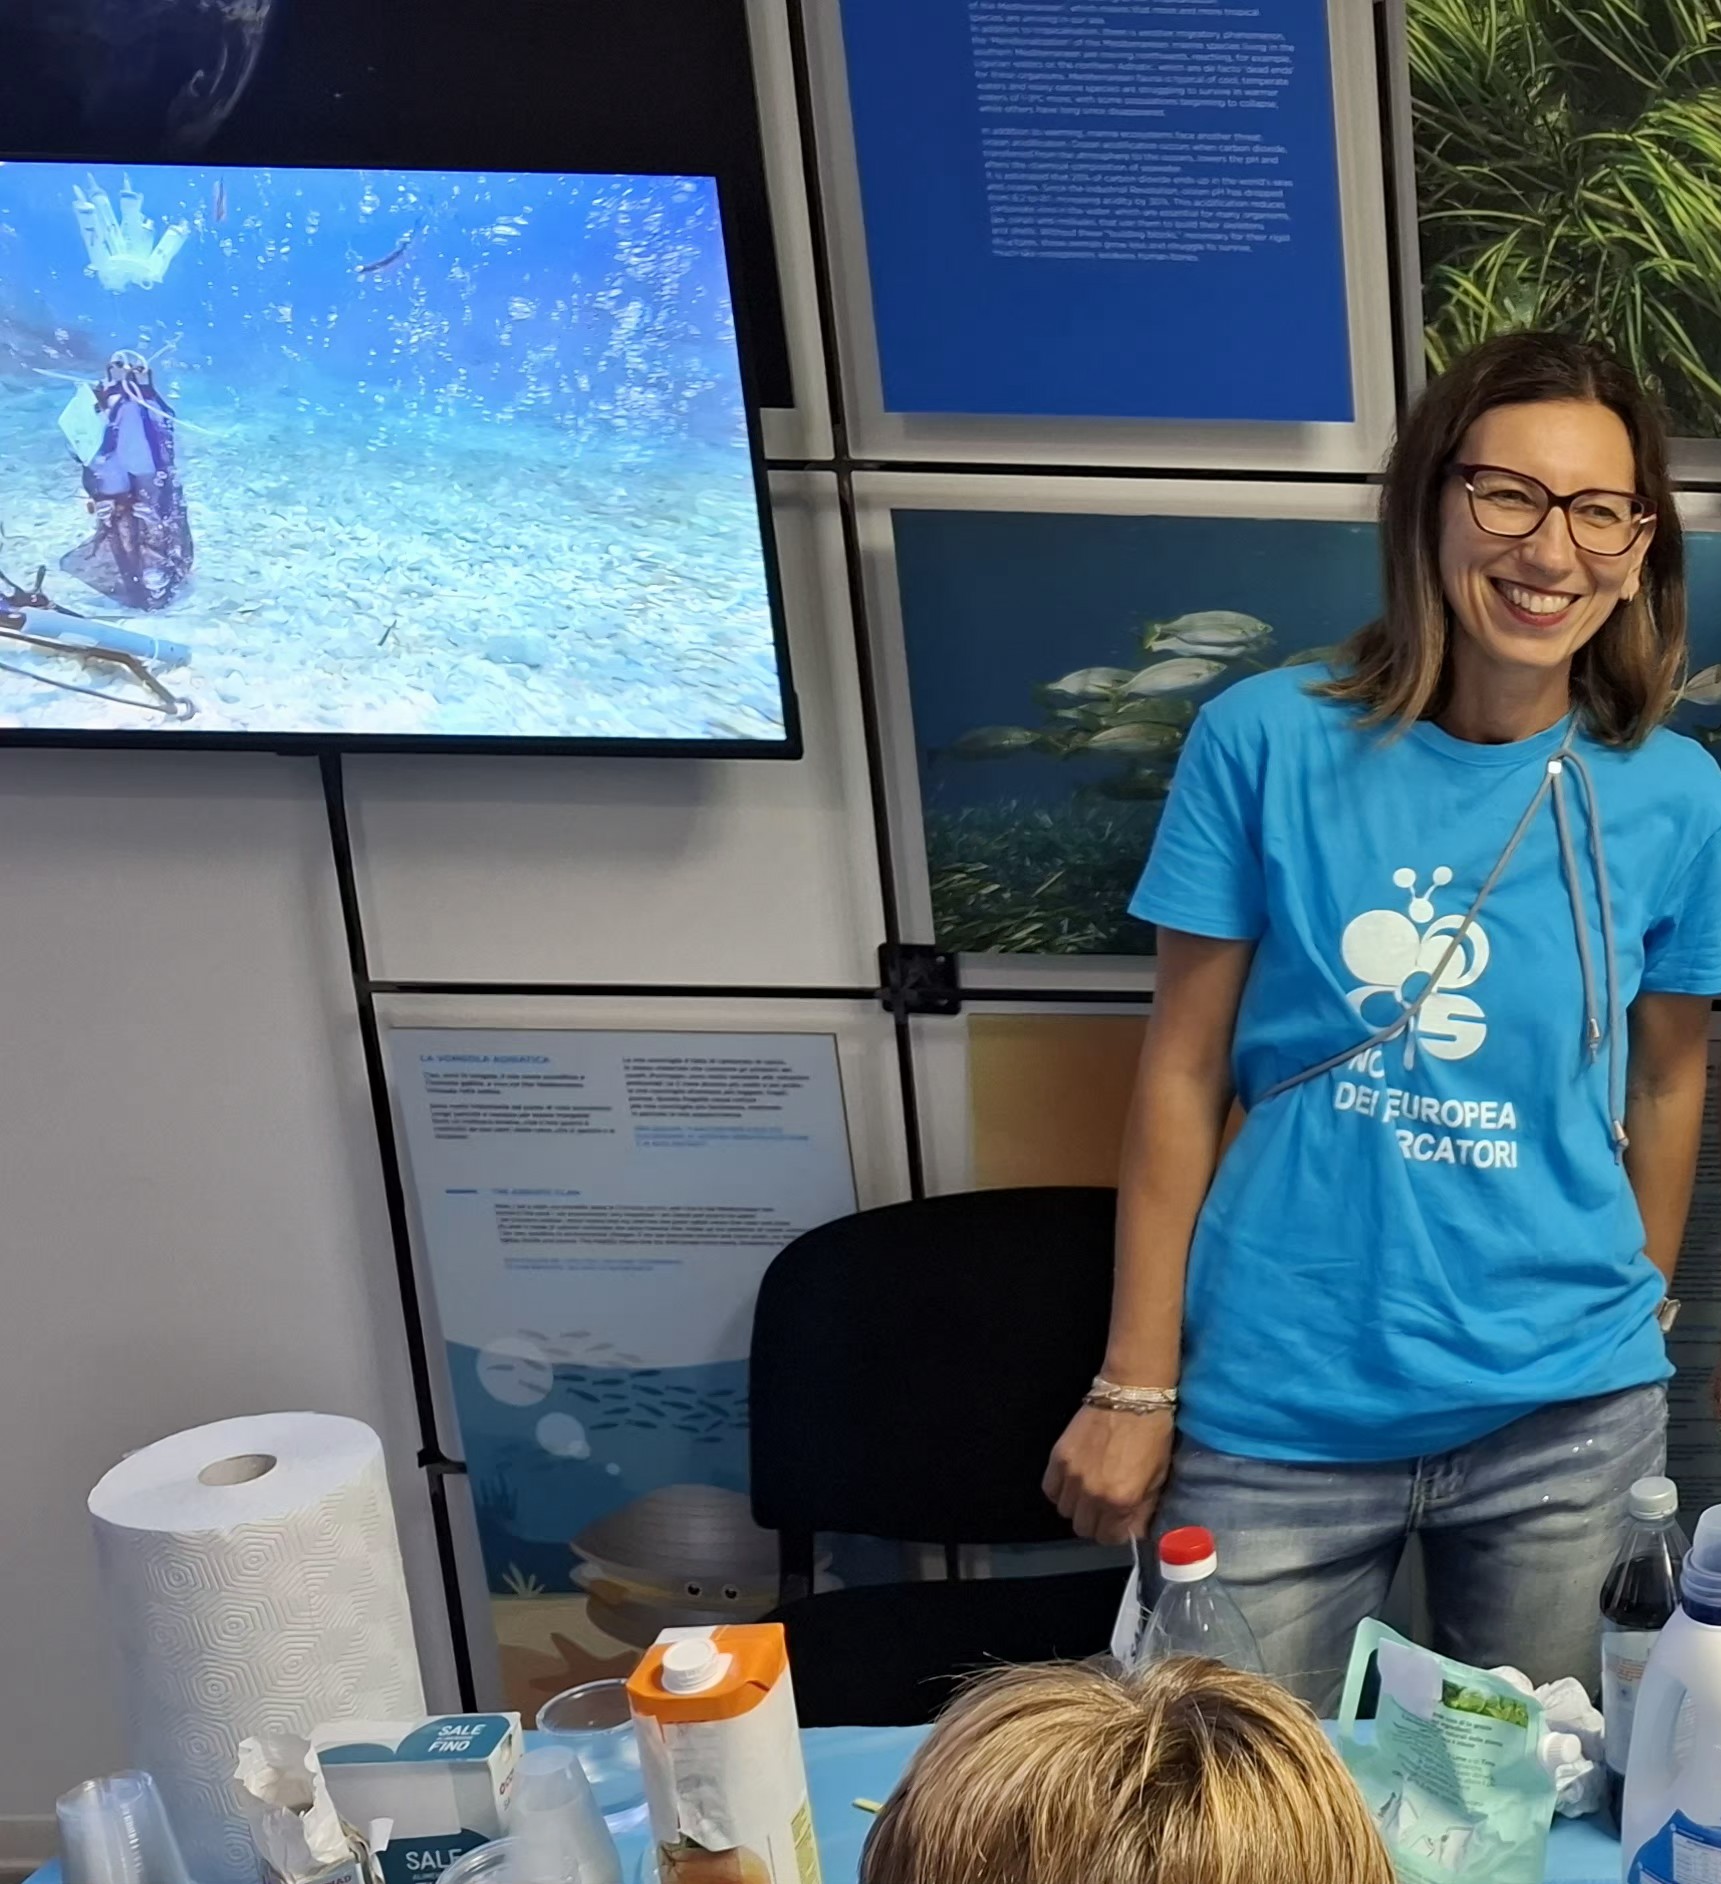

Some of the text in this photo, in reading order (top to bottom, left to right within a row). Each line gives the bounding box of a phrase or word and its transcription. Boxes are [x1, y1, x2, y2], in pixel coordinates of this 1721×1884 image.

[1334, 1082, 1517, 1129] DEI EUROPEA
[1395, 1129, 1518, 1168] RCATORI
[438, 1724, 487, 1736] SALE
[428, 1740, 471, 1752] FINO
